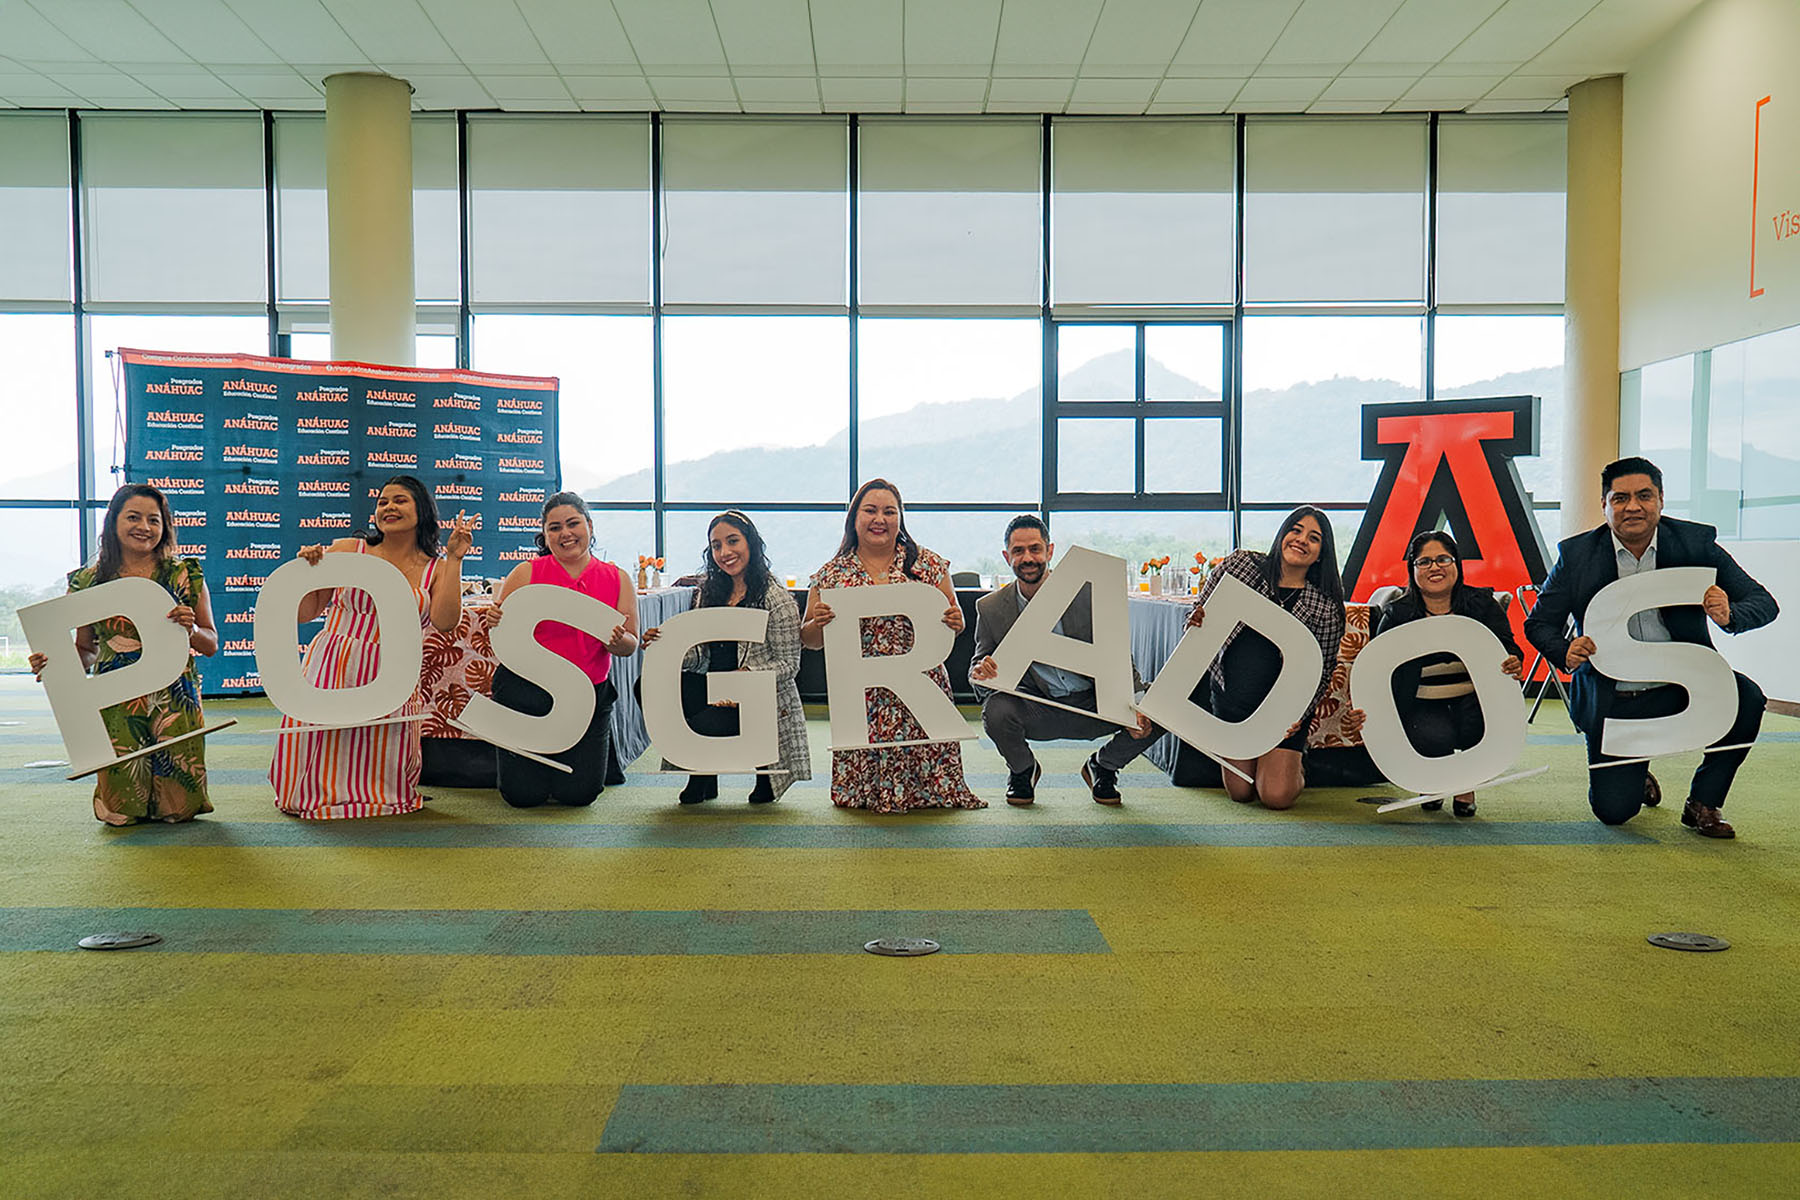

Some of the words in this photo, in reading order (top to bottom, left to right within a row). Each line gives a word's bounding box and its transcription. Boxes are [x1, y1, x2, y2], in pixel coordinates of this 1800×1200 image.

[146, 382, 203, 395] ANÁHUAC
[223, 379, 278, 393] ANÁHUAC
[296, 390, 348, 402] ANÁHUAC
[366, 390, 416, 402] ANÁHUAC
[433, 396, 480, 410] ANÁHUAC
[497, 398, 542, 410] ANÁHUAC
[147, 410, 204, 422] ANÁHUAC
[224, 417, 278, 431] ANÁHUAC
[297, 417, 348, 428] ANÁHUAC
[434, 422, 480, 435] ANÁHUAC
[367, 425, 416, 437] ANÁHUAC
[497, 432, 543, 443] ANÁHUAC
[145, 449, 203, 461] ANÁHUAC
[223, 444, 278, 457] ANÁHUAC
[297, 453, 350, 465] ANÁHUAC
[368, 451, 417, 463] ANÁHUAC
[498, 457, 544, 468] ANÁHUAC
[435, 458, 482, 470] ANÁHUAC
[147, 476, 204, 488] ANÁHUAC
[298, 480, 350, 491] ANÁHUAC
[224, 482, 279, 495] ANÁHUAC
[435, 483, 482, 495] ANÁHUAC
[499, 491, 544, 502] ANÁHUAC
[172, 517, 206, 526] HUAC
[226, 509, 280, 522] ANÁHUAC
[299, 517, 351, 528] ANÁHUAC
[172, 545, 206, 554] HUAC
[226, 547, 280, 559] ANÁHUAC
[225, 574, 268, 586] ANÁHU
[225, 611, 255, 623] ANÁH
[223, 638, 255, 650] ANÁH
[222, 676, 263, 688] ANÁHU
